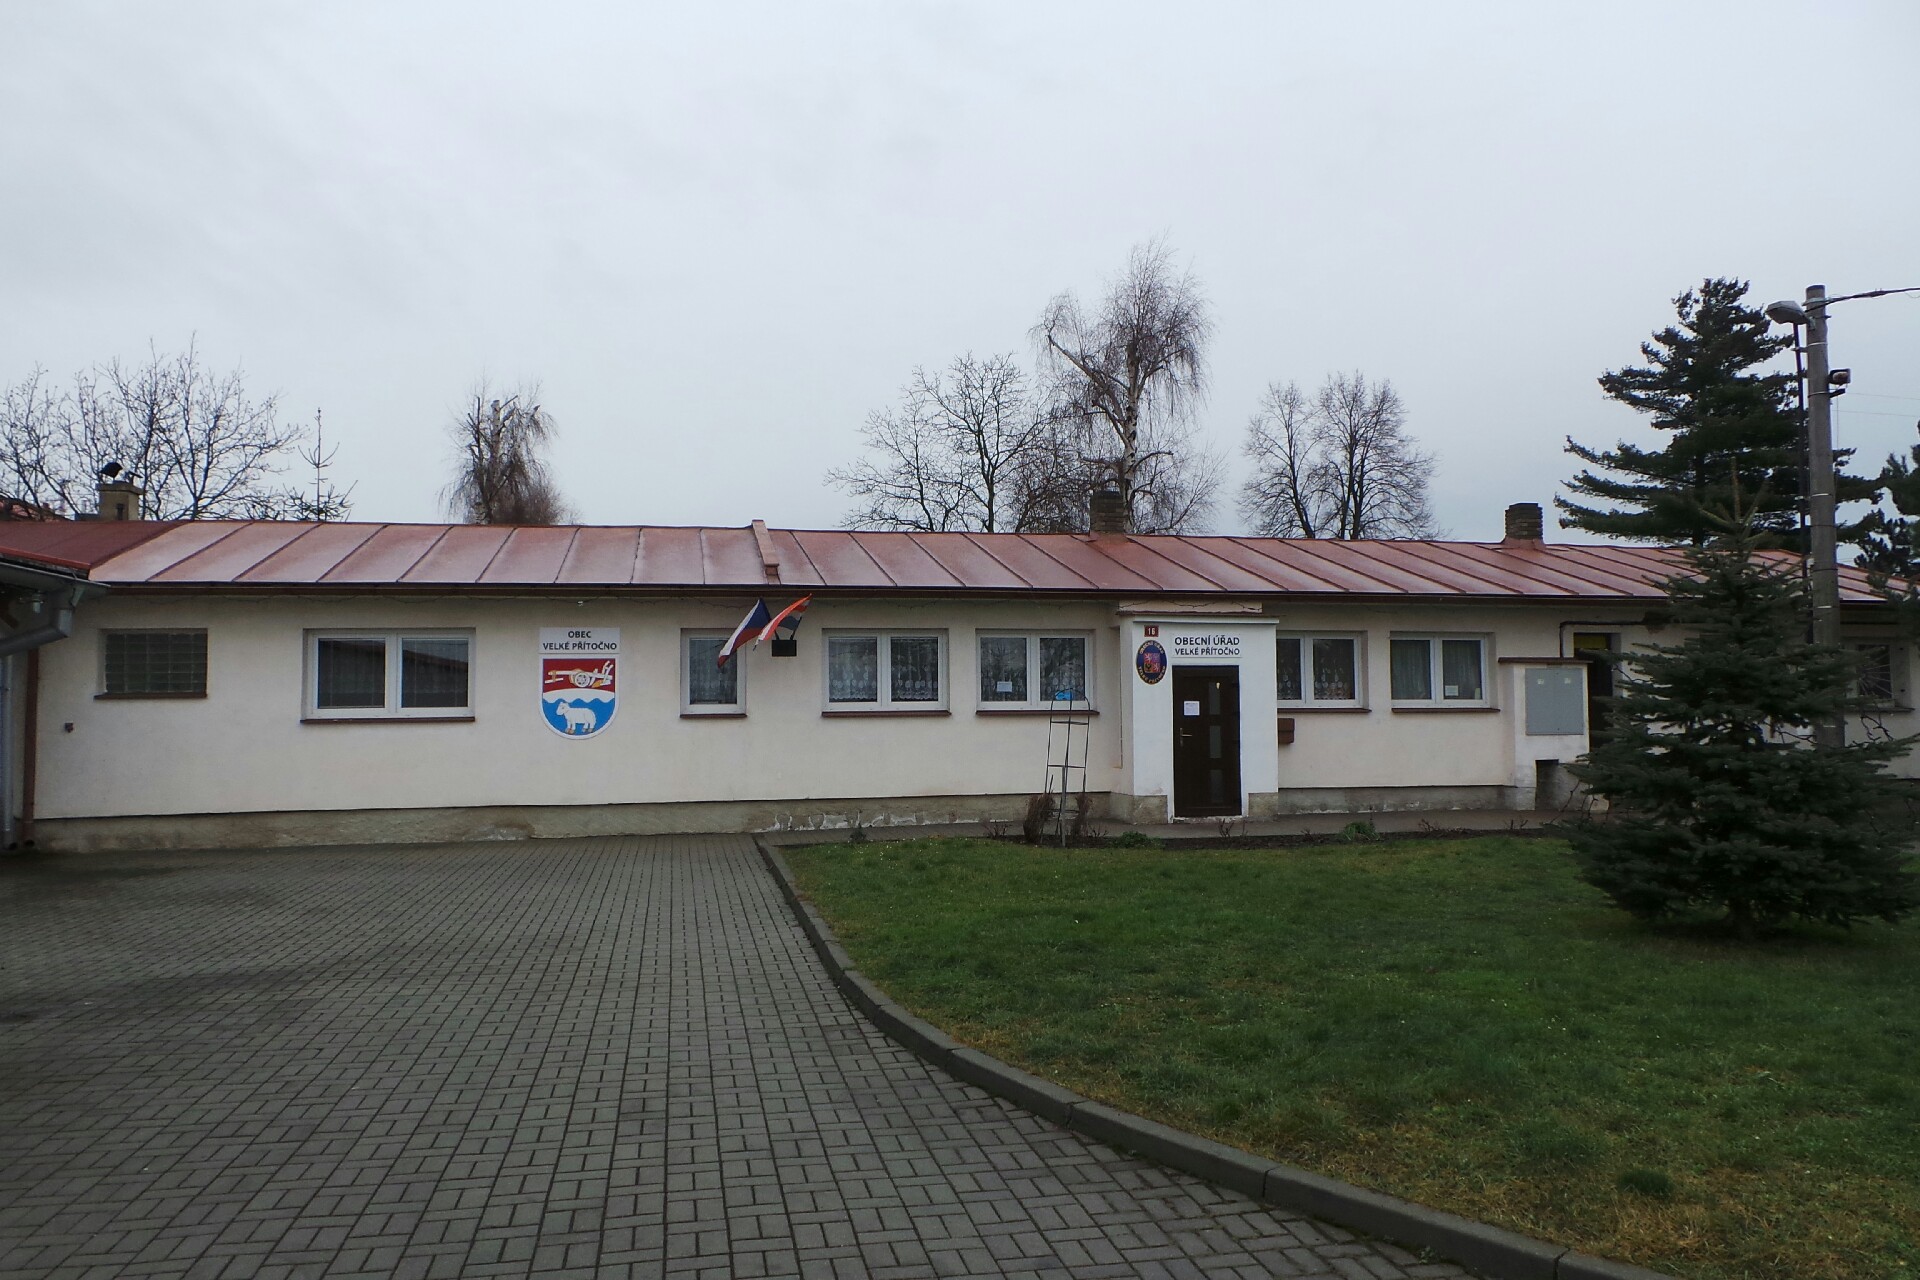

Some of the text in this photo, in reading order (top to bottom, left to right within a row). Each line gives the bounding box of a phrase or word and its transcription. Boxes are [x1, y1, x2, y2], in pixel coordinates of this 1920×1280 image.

[567, 630, 592, 639] OBEC
[1148, 627, 1156, 635] 16
[1174, 635, 1240, 645] OBECNÍ ÚŘAD
[542, 640, 618, 650] VELKÉ PŘÍTOČNO
[1175, 647, 1240, 655] VELKÉ PŘÍTOČNO
